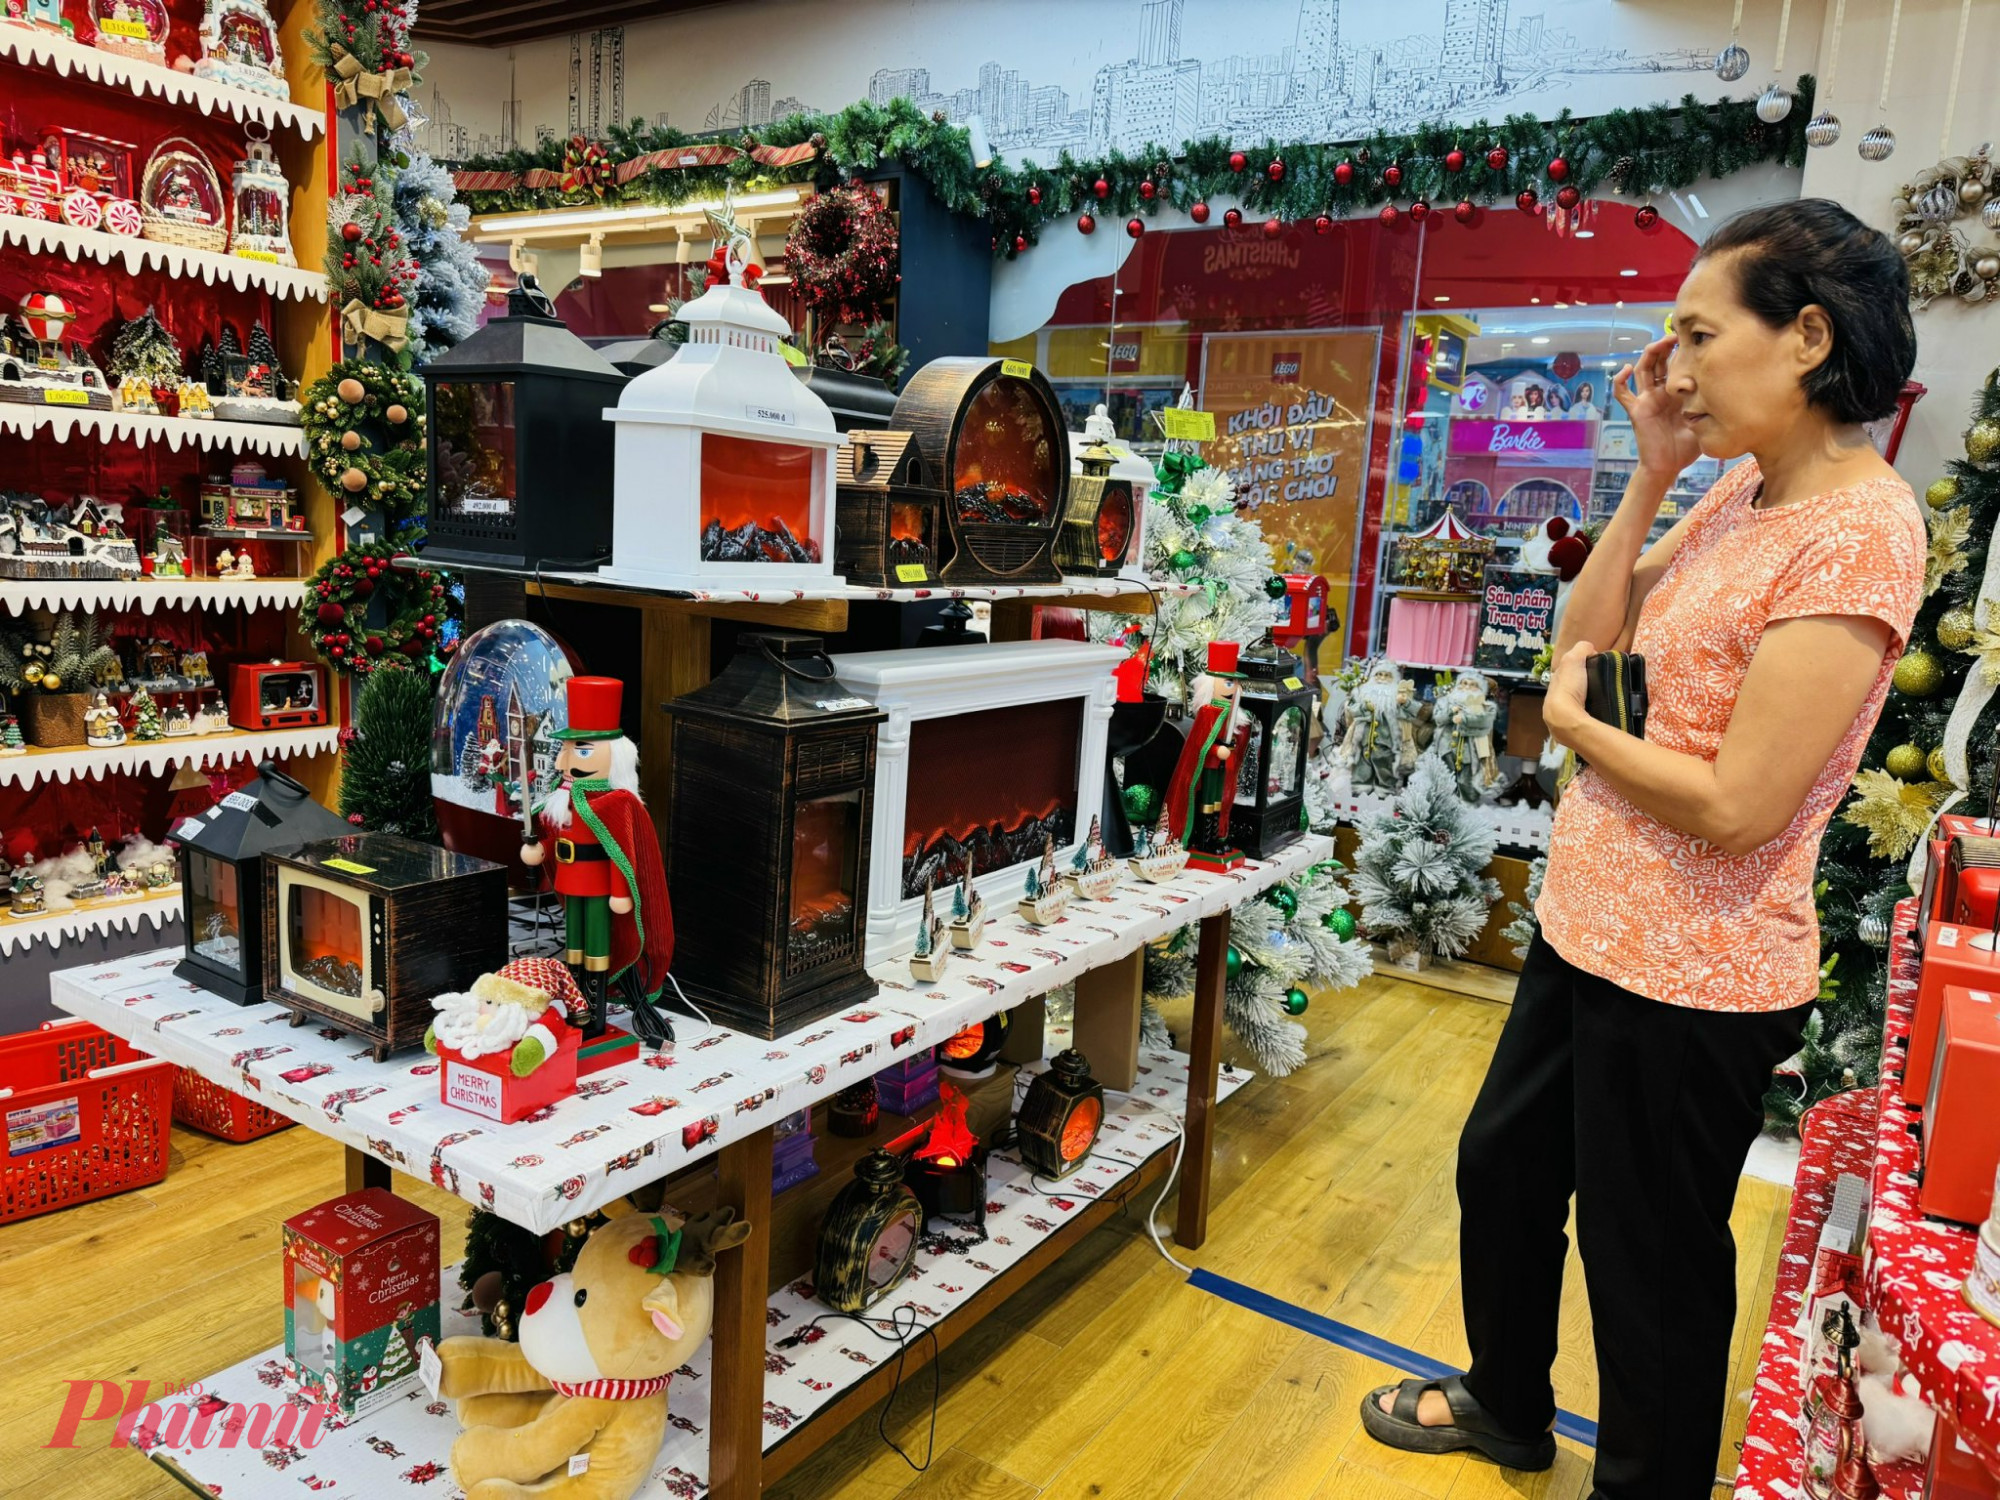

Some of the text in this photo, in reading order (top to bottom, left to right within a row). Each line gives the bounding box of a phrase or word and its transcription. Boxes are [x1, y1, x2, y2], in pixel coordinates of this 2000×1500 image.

[104, 22, 143, 35] 1.315.000
[1112, 344, 1138, 359] LEGO
[1274, 362, 1299, 375] LEGO
[1227, 401, 1283, 436] KHỞI
[1286, 390, 1335, 425] ĐẦU
[1488, 423, 1546, 452] Barbie
[1290, 454, 1334, 480] TẠO
[1283, 475, 1338, 502] CHƠI
[1486, 585, 1553, 611] Sản phẩm
[1486, 605, 1548, 632] Trang trí
[457, 1072, 490, 1092] MERRY
[450, 1086, 498, 1109] CHRISTMAS
[333, 1203, 382, 1230] Christmas
[368, 1274, 420, 1304] Christmas
[380, 1270, 408, 1289] Merry
